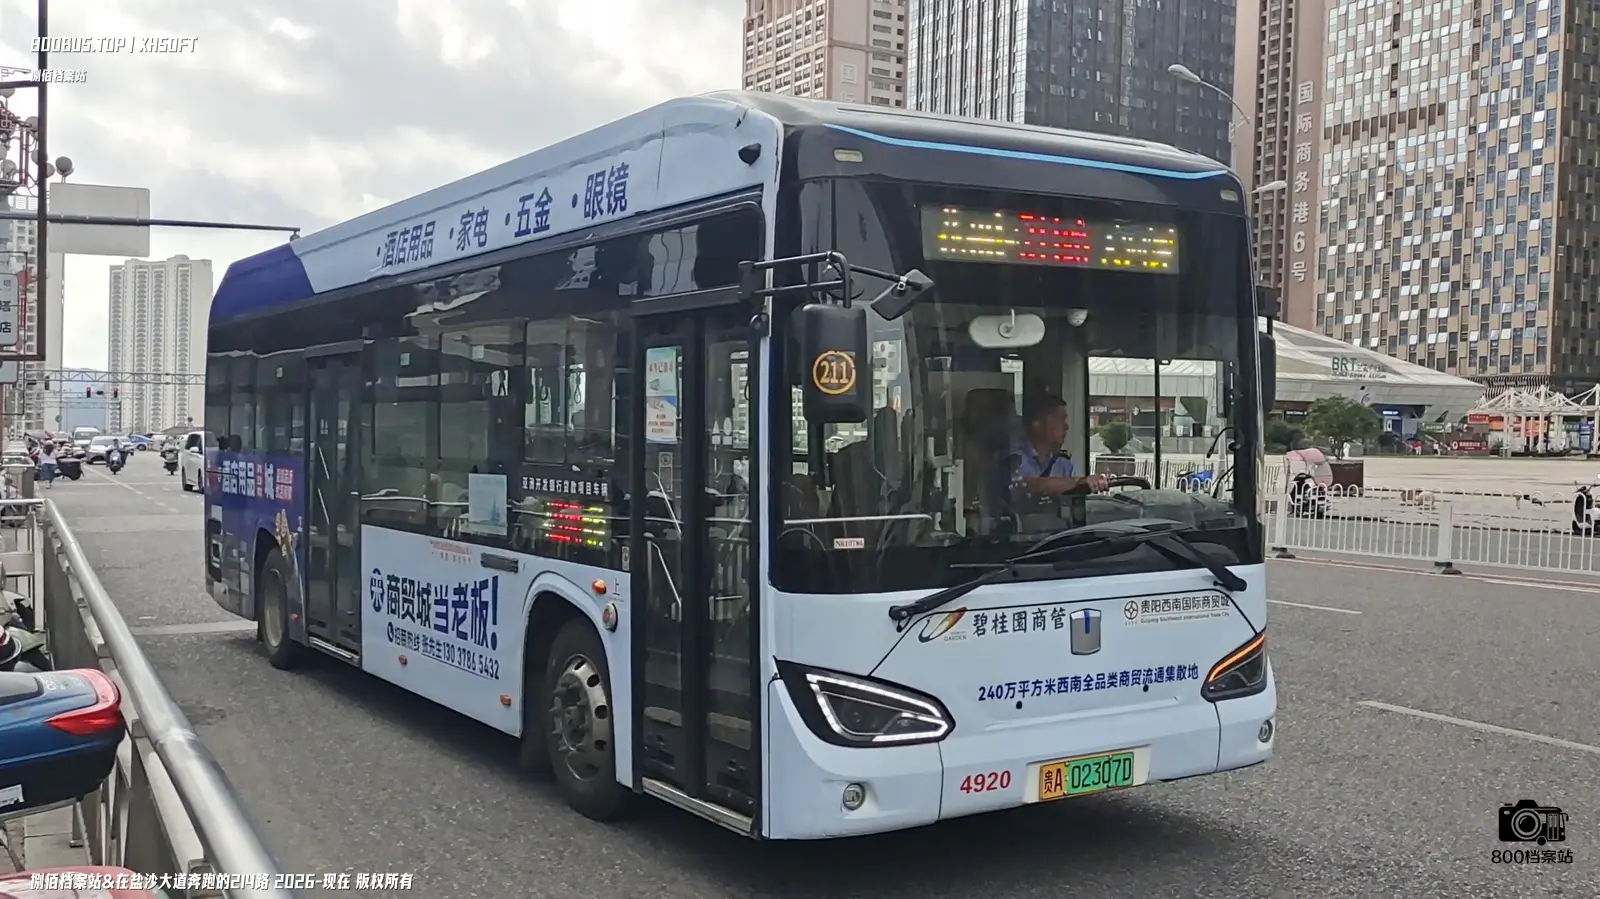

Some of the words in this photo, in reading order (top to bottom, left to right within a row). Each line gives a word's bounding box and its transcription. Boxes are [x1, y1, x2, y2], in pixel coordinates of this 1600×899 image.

[1291, 80, 1314, 282] 国际商务港6号
[820, 360, 849, 384] 211
[1332, 356, 1358, 371] BRT
[1141, 595, 1230, 614] 贵阳西南国际商贸城
[457, 645, 477, 672] 3786
[479, 653, 500, 681] 5432
[978, 662, 1199, 701] 240万平方米西南全品类商贸流通集散地
[960, 770, 1012, 794] 4920
[1071, 757, 1132, 789] 02307D
